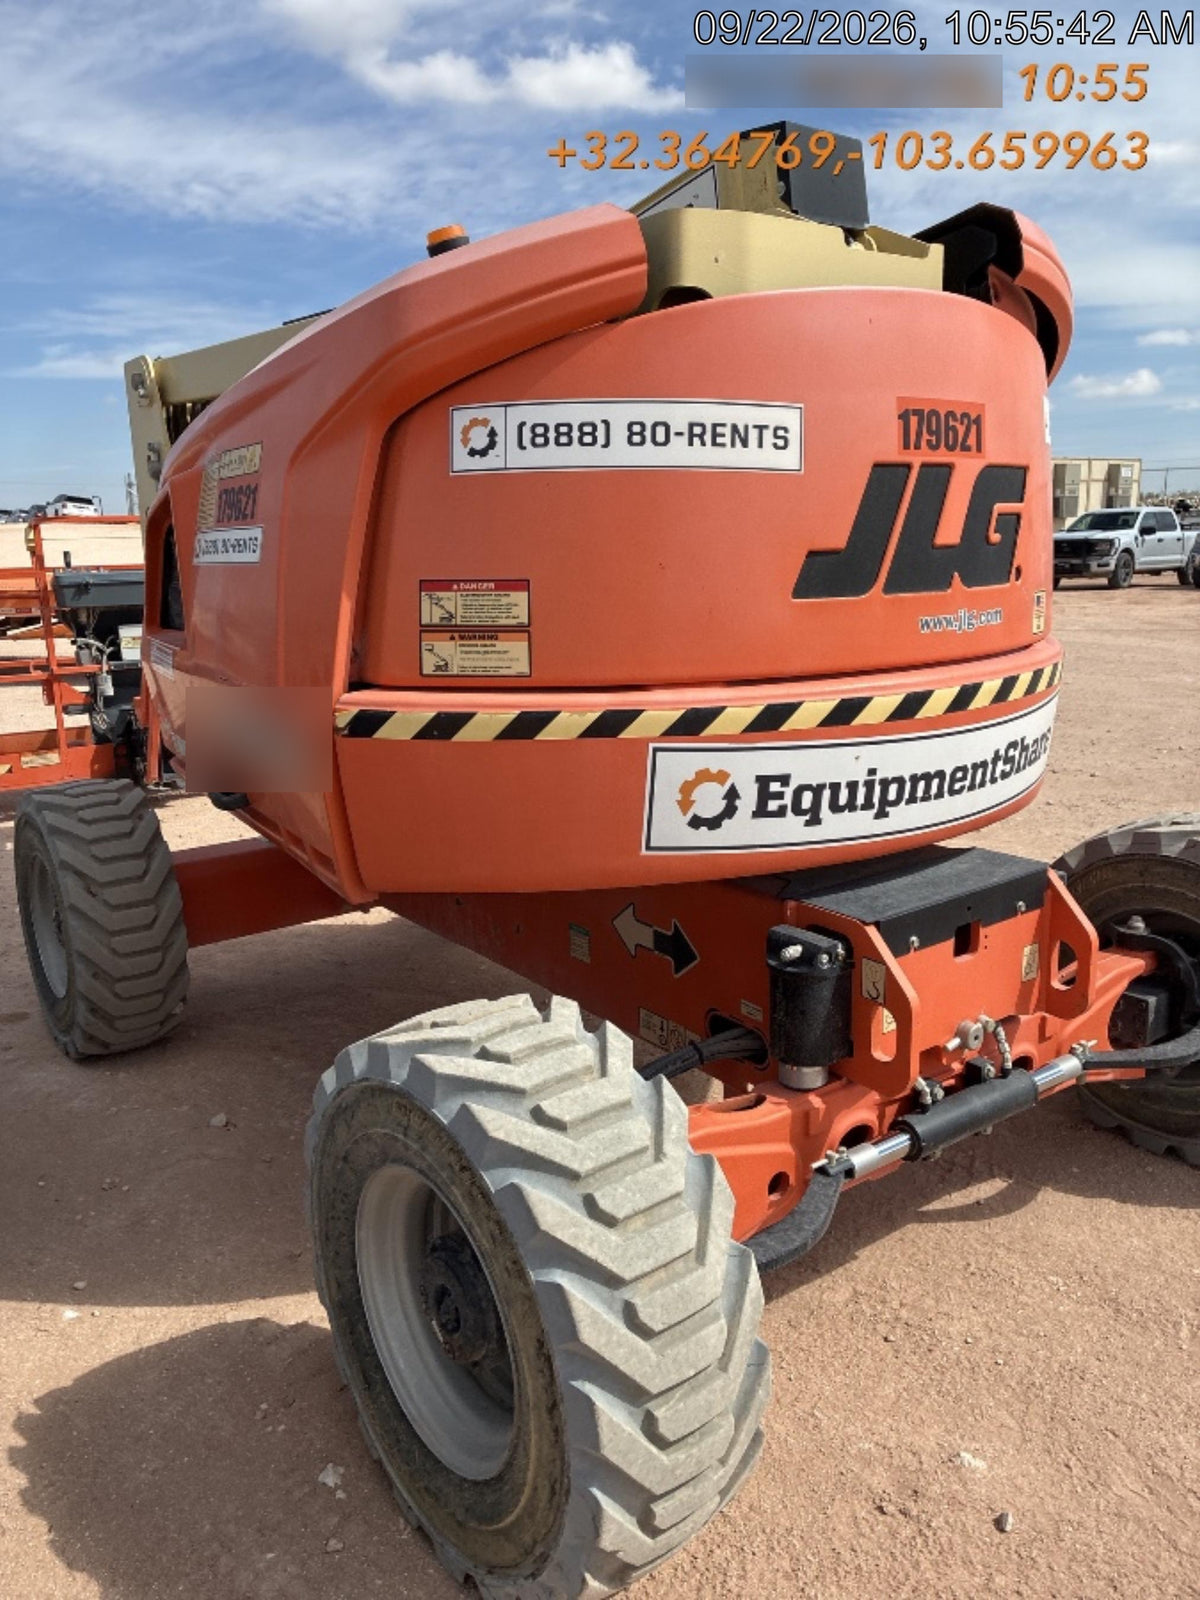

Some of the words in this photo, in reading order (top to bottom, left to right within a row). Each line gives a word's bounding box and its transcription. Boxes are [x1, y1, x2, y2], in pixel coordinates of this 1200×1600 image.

[517, 419, 611, 451] (888)
[627, 420, 790, 451] 80-RENTS
[897, 408, 982, 453] 179621
[919, 607, 1003, 633] www.jlg.com
